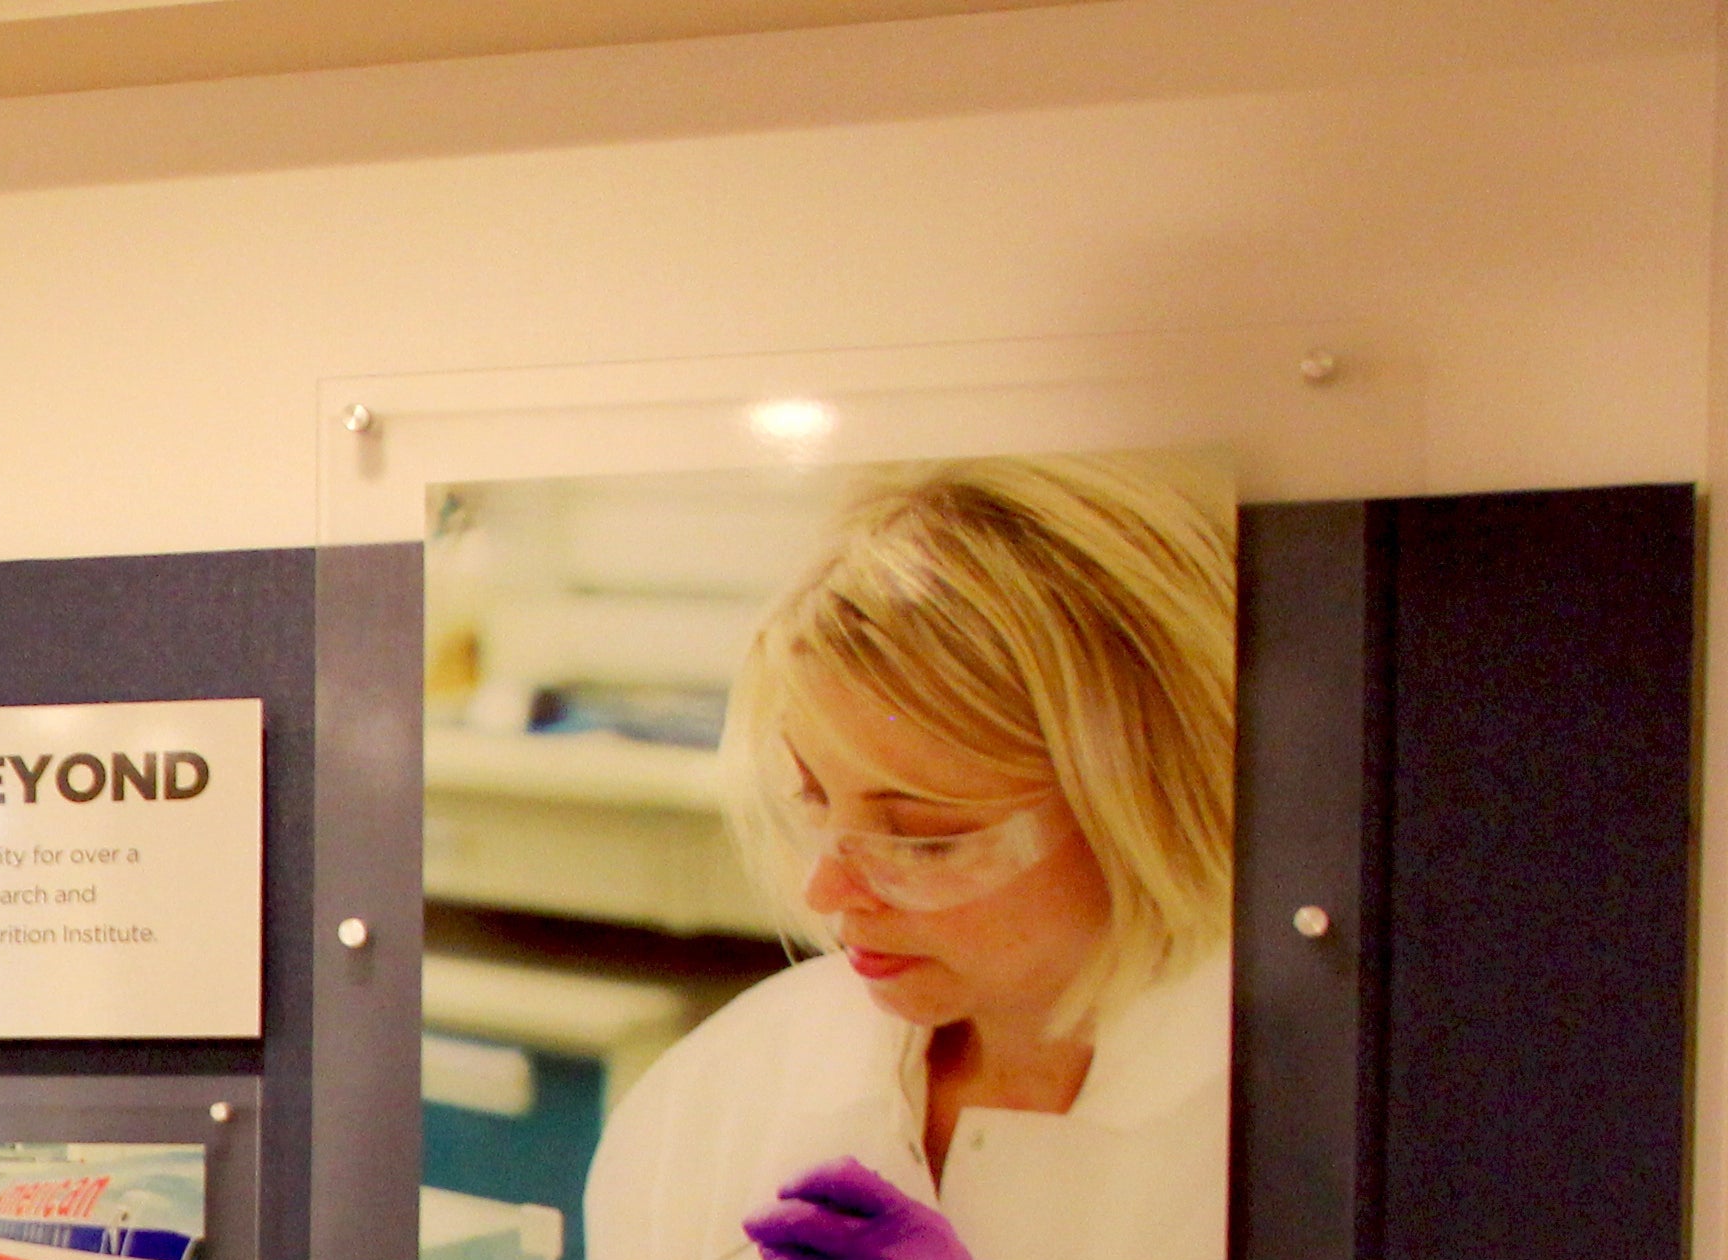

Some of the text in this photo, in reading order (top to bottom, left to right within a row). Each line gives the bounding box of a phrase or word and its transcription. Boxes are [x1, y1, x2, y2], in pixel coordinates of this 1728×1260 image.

[32, 844, 64, 867] for
[69, 847, 121, 865] over
[125, 847, 141, 866] a
[54, 883, 98, 905] and
[62, 924, 158, 945] Institute.
